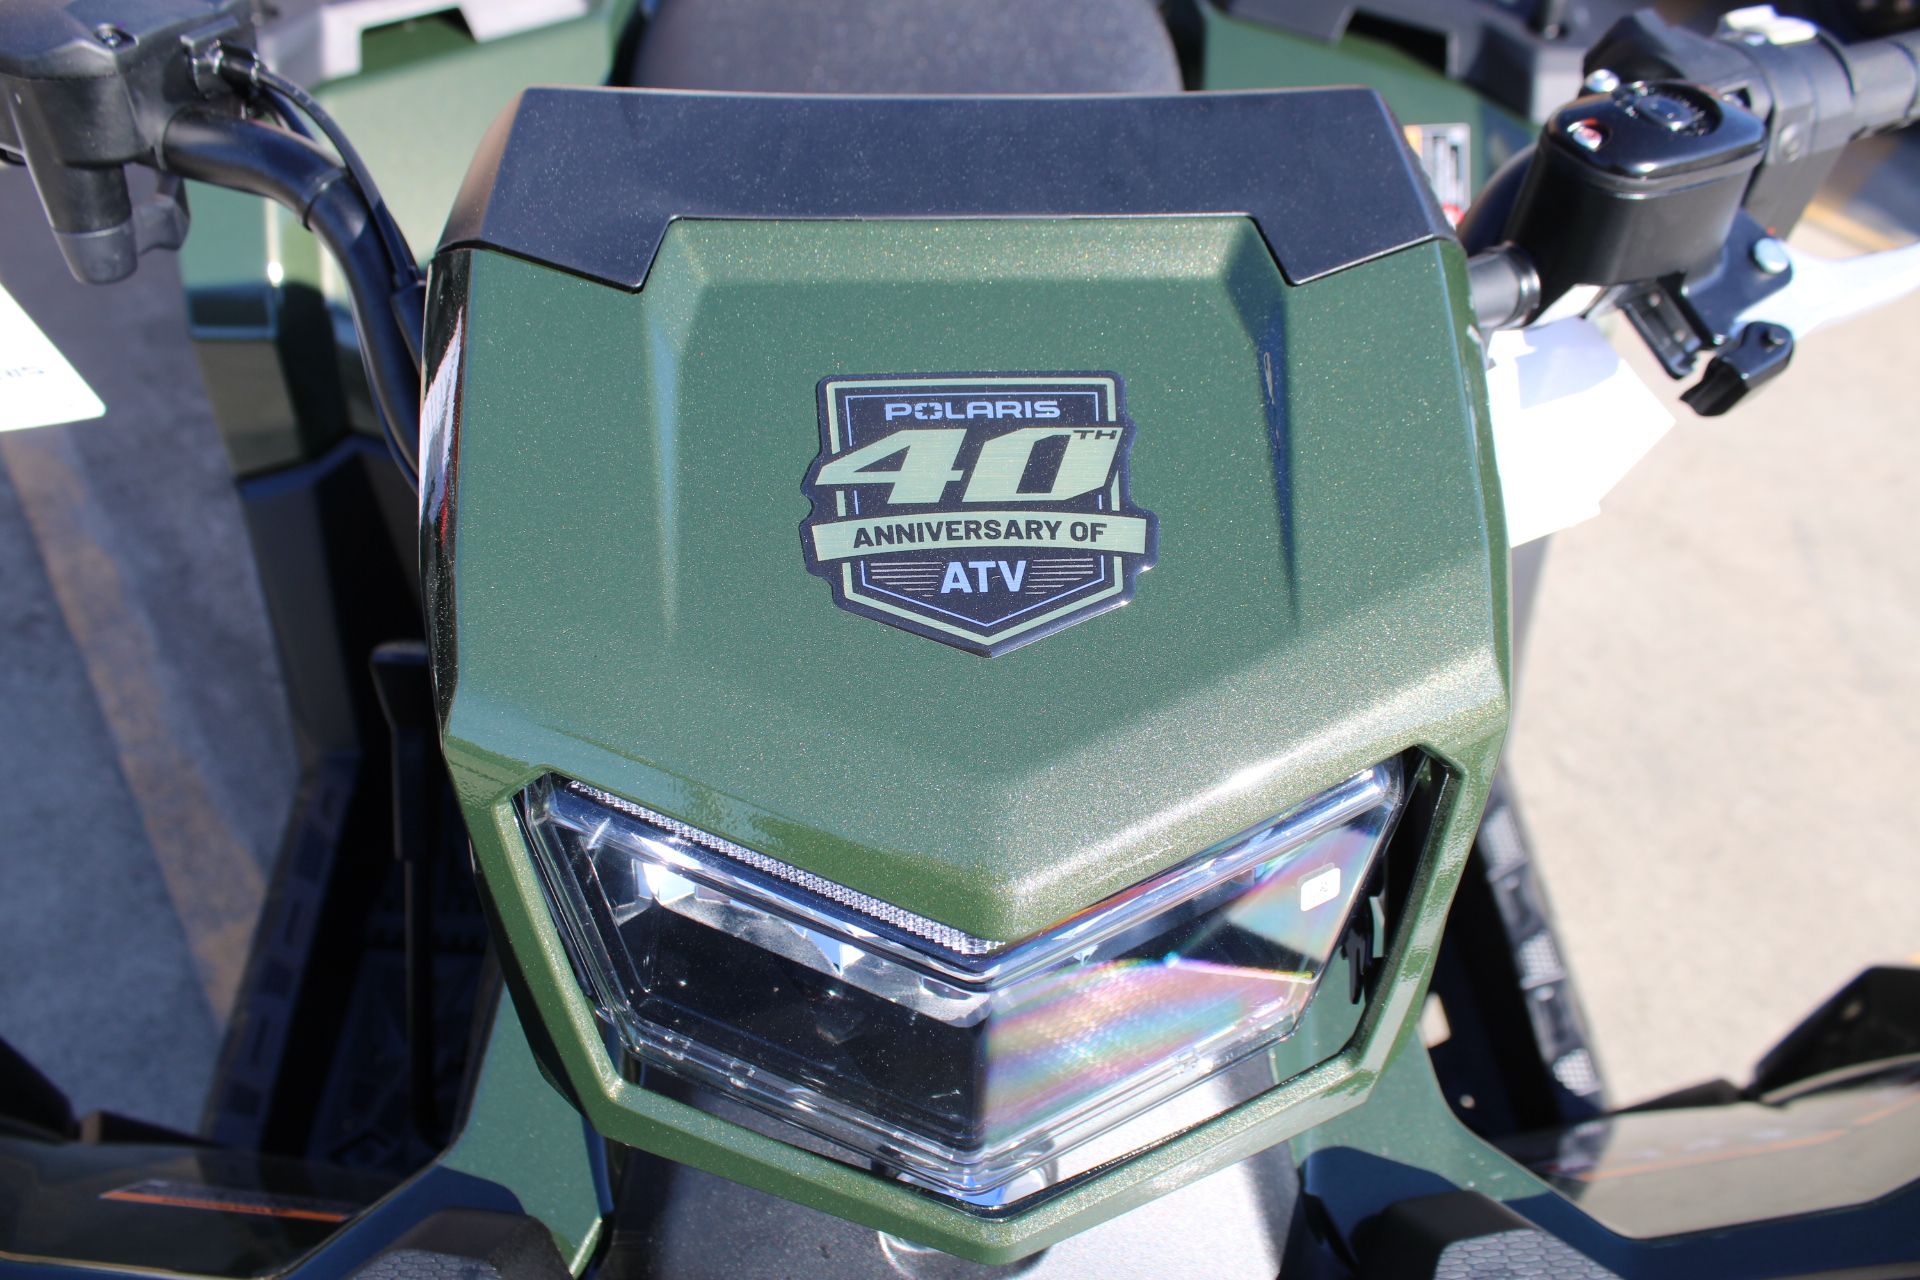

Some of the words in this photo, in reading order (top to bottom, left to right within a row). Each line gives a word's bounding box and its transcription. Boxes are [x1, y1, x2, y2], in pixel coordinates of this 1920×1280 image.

[885, 400, 1061, 421] POLARIS
[853, 519, 1061, 549] ANNIVERSARY
[1069, 522, 1107, 543] OF
[940, 560, 1027, 594] ATV
